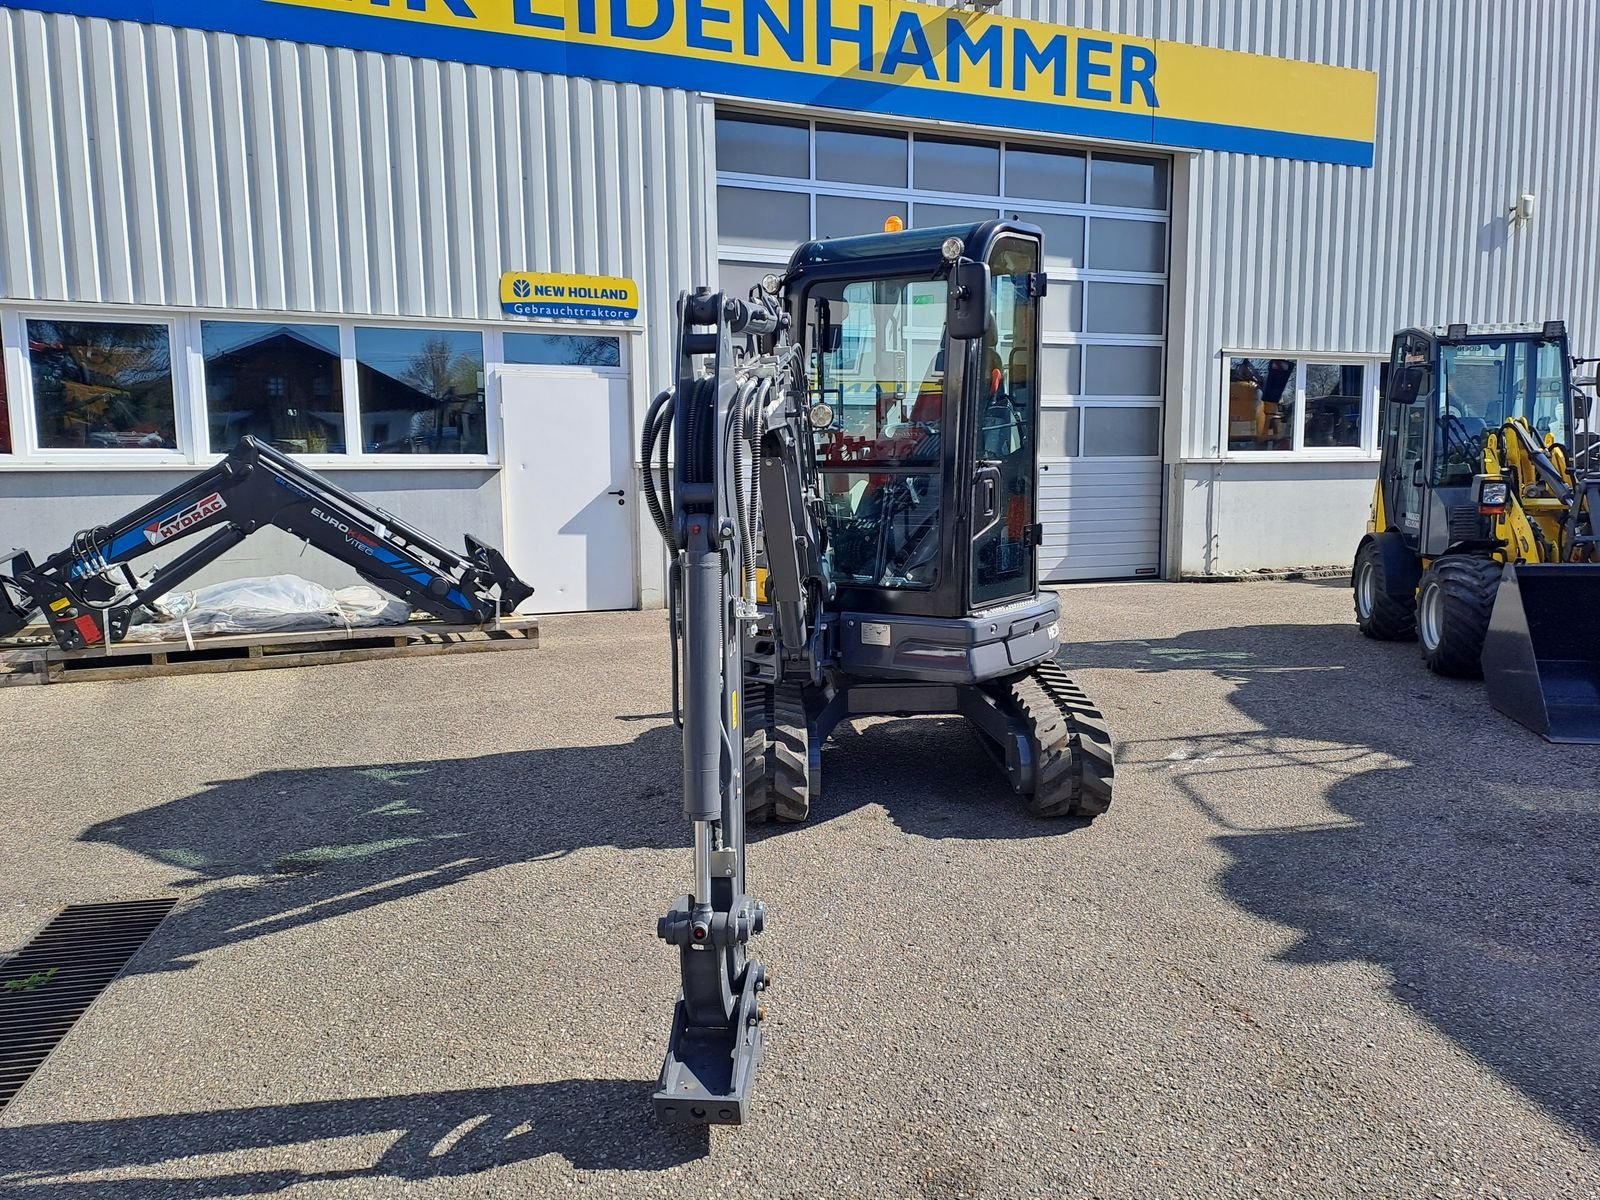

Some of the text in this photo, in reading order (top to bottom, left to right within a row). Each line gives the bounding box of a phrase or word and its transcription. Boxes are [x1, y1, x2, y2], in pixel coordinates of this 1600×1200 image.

[534, 285, 628, 301] NEW HOLLAND
[513, 303, 630, 318] Gebrauchttraktore
[160, 501, 222, 538] HYDRAC
